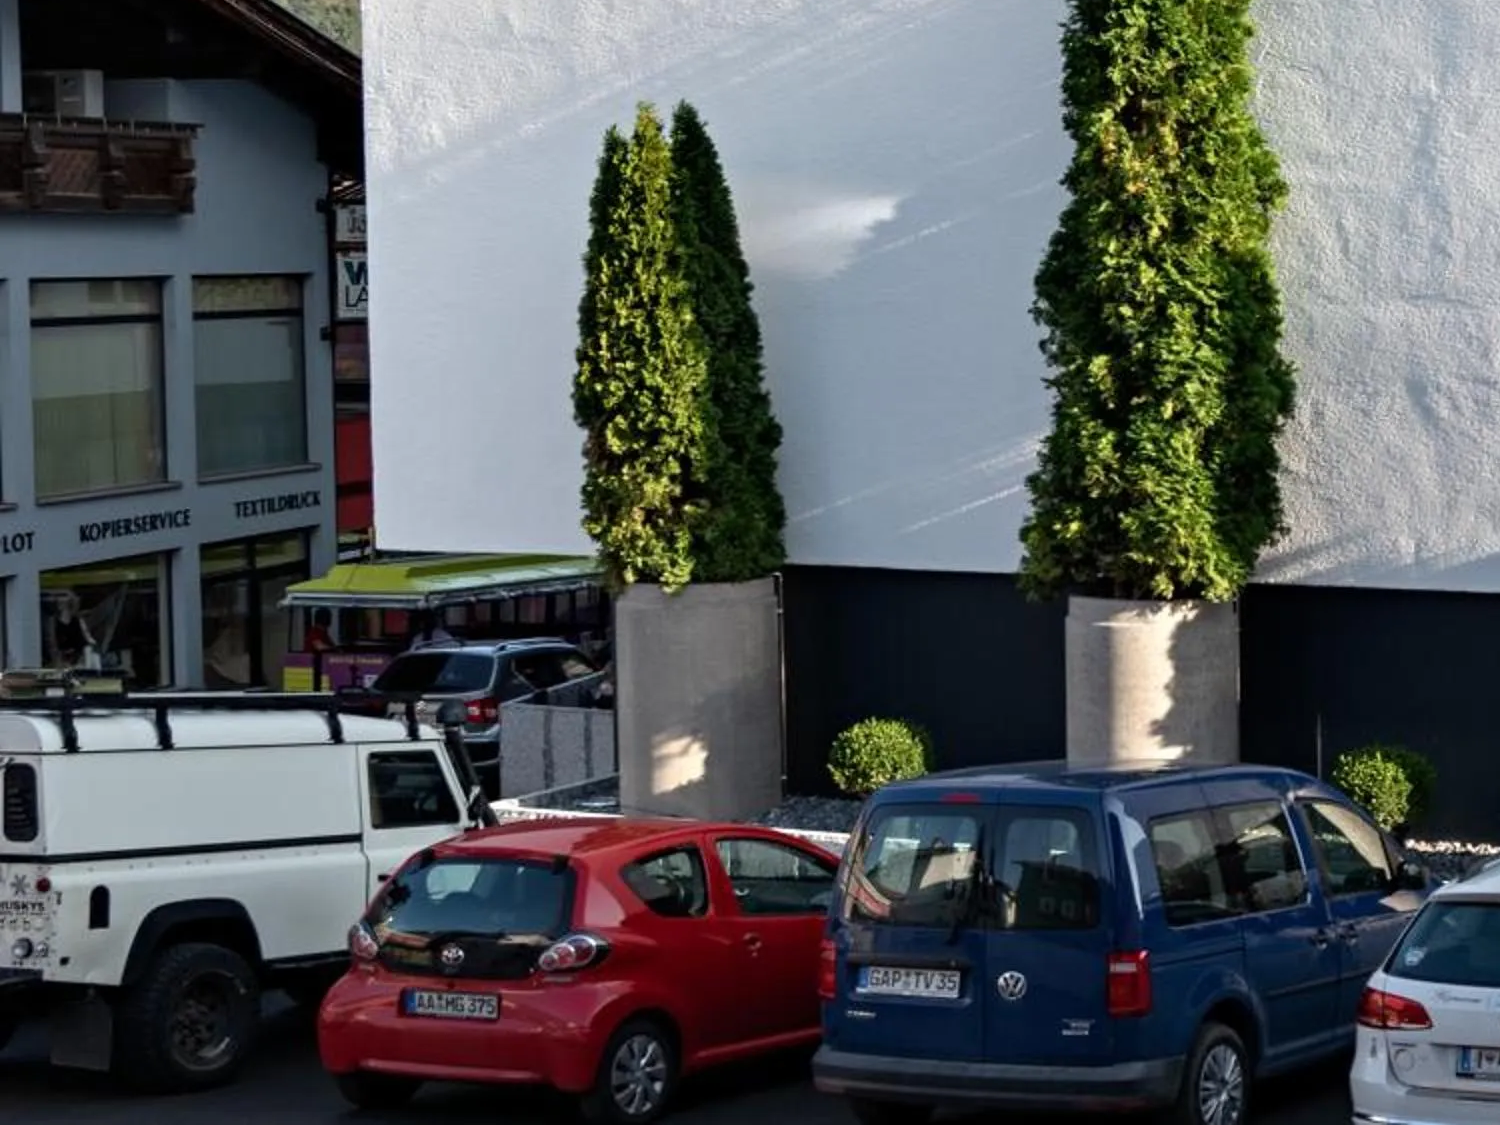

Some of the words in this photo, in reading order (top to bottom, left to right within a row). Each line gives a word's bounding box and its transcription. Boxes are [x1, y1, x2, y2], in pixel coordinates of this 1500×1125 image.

[0, 531, 35, 554] LOT
[79, 509, 191, 543] KOPIERSERVICE
[233, 491, 321, 518] TEXTILDRUCK
[870, 969, 901, 988] GAP
